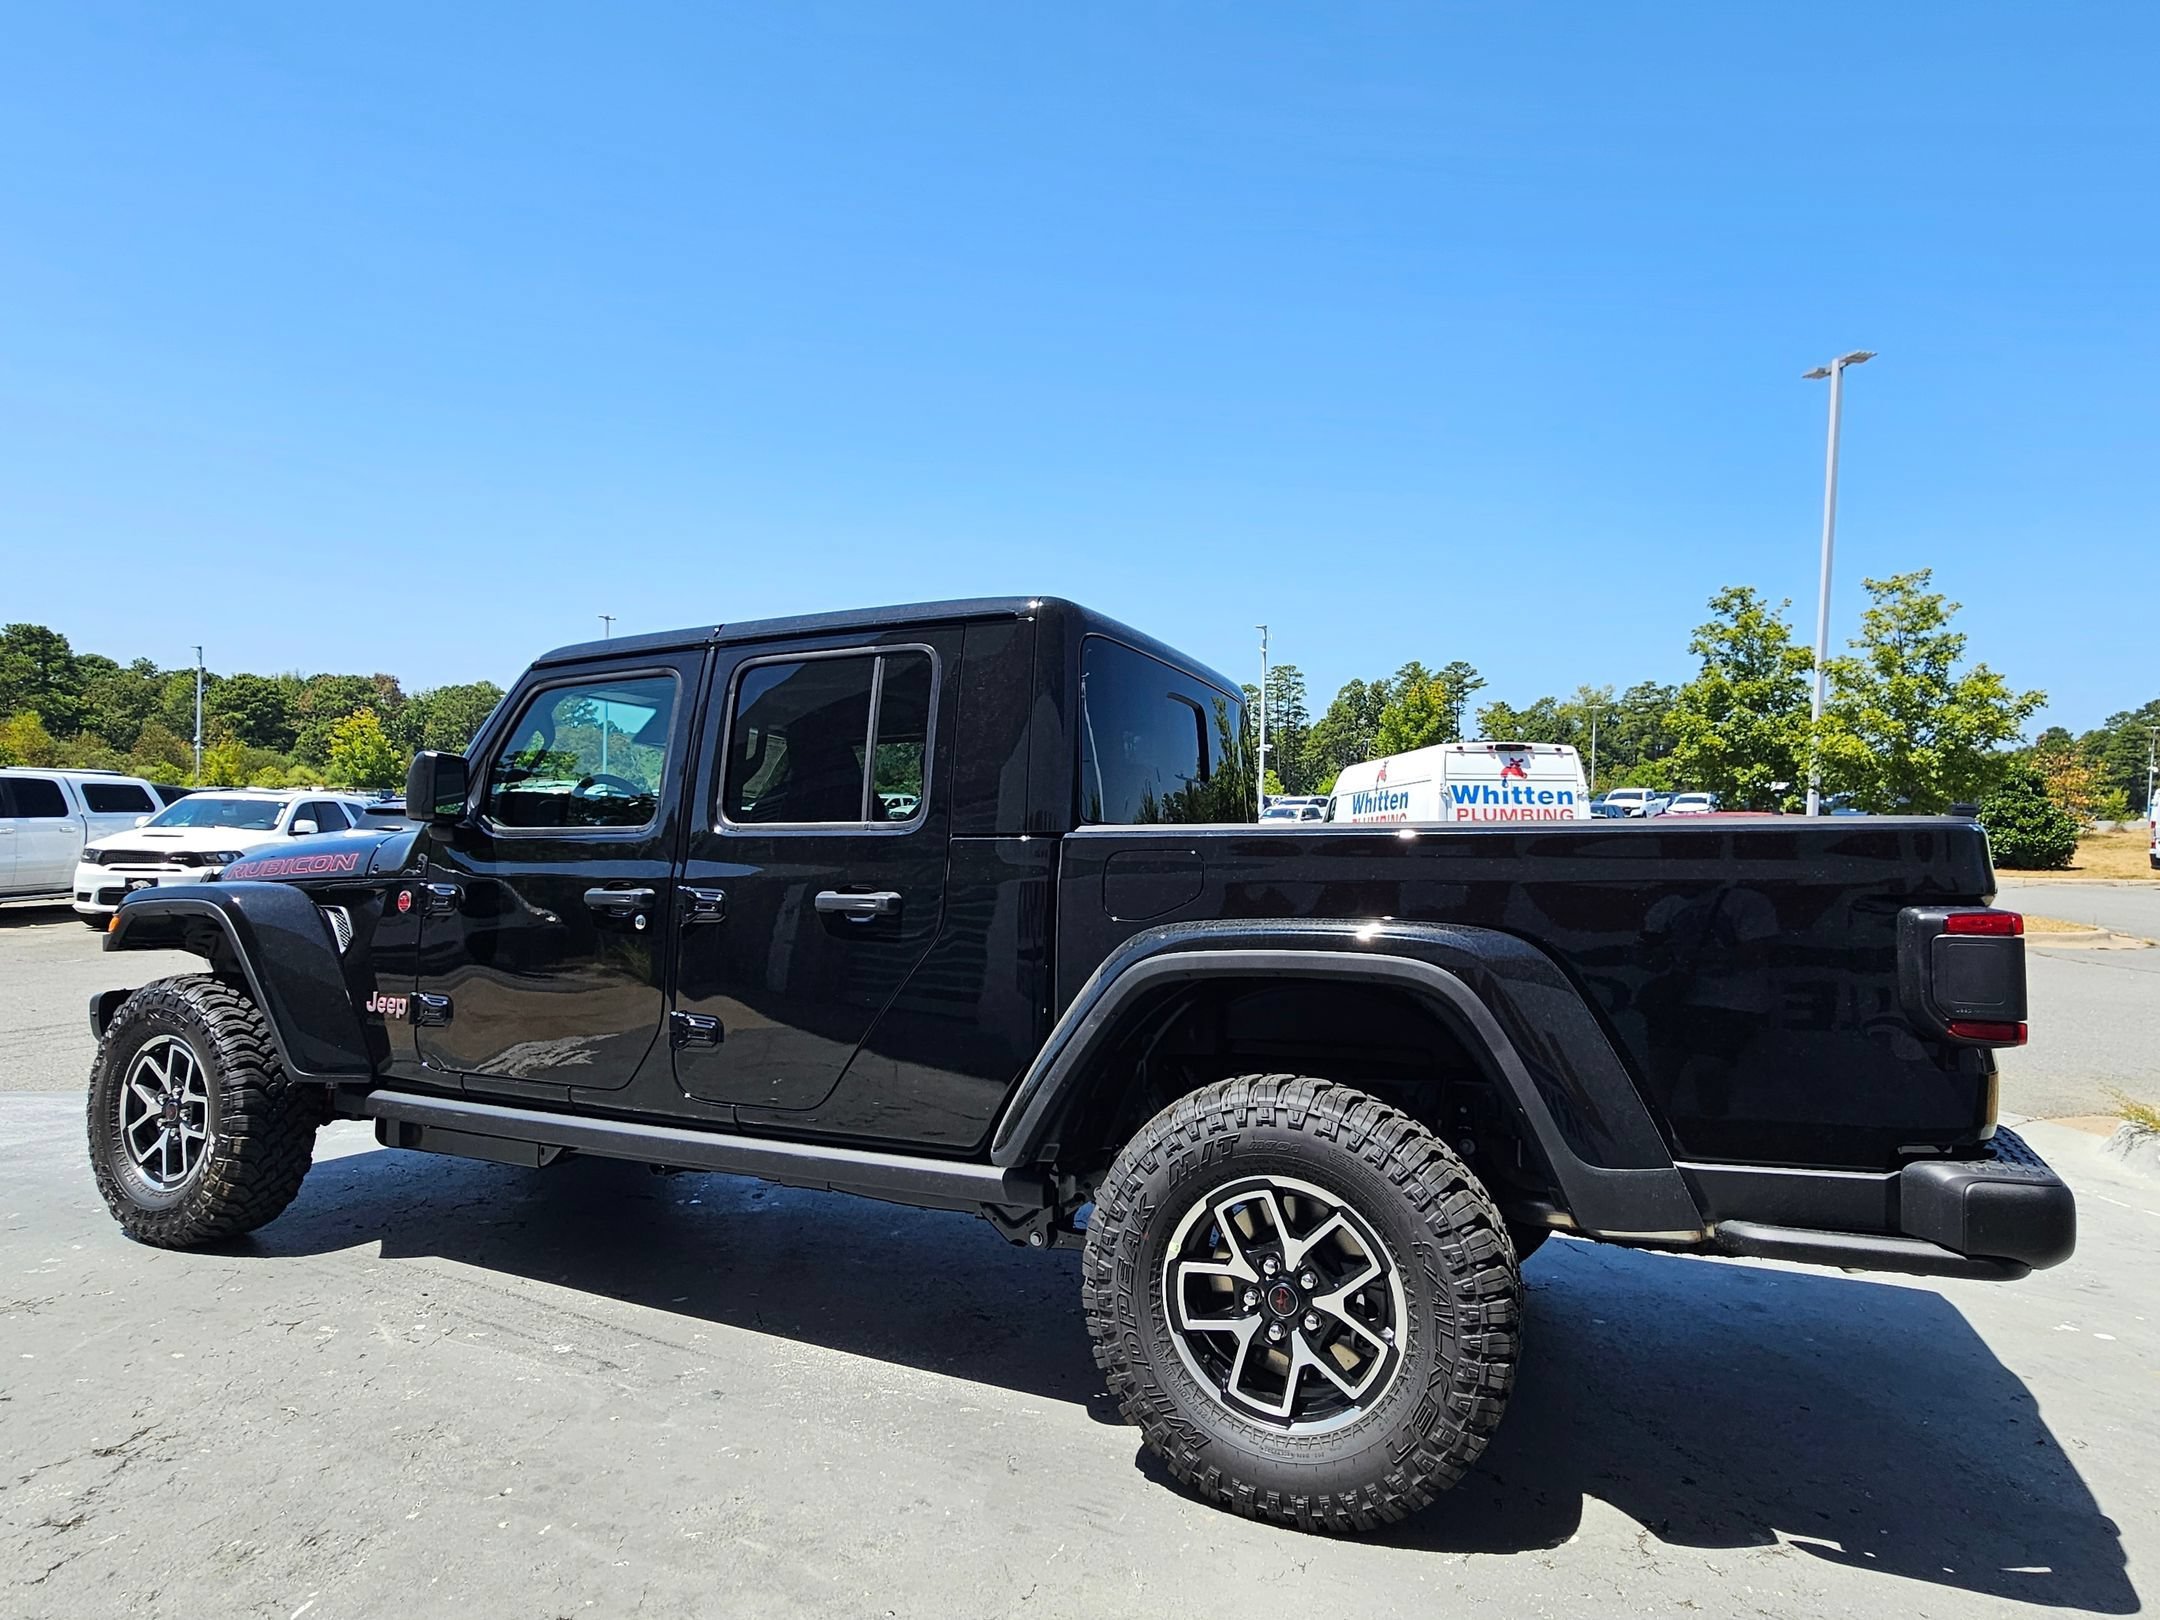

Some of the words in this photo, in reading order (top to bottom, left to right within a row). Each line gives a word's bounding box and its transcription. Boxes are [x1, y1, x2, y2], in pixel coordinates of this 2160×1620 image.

[1352, 790, 1409, 815] Whitten
[1450, 784, 1574, 805] Whitten
[1456, 808, 1574, 821] PLUMBING
[225, 852, 359, 880] RUBICON
[366, 991, 407, 1019] Jeep
[1116, 1191, 1212, 1449] WILDPEAK
[1167, 1132, 1242, 1189] M/T
